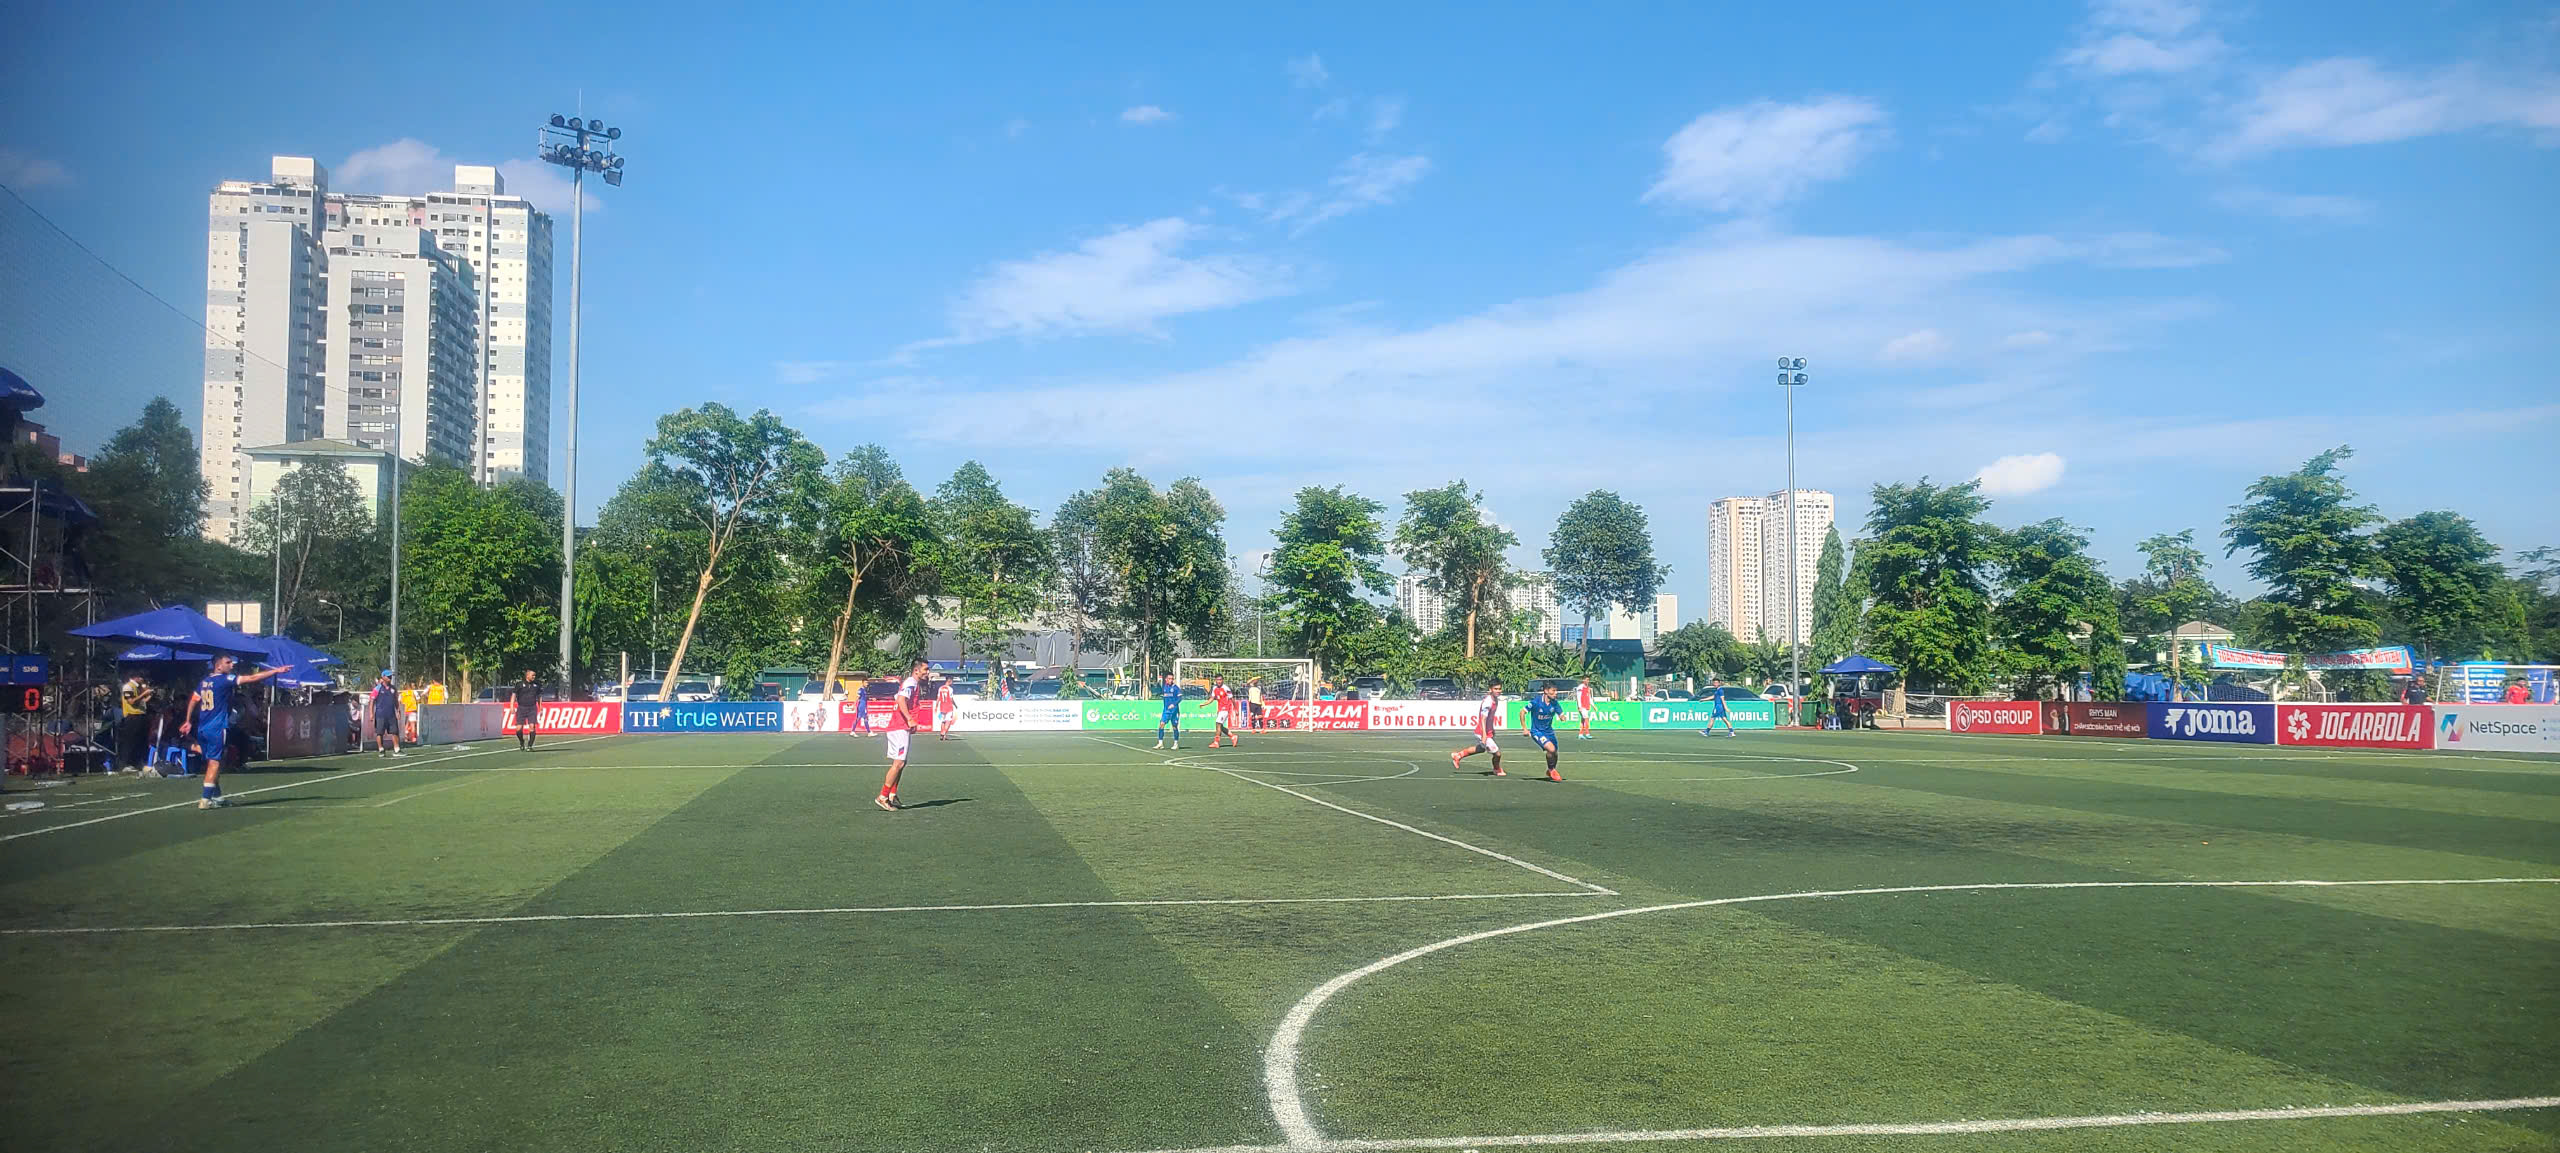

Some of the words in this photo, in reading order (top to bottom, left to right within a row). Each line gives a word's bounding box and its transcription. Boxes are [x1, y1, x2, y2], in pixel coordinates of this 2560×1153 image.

[24, 688, 40, 711] 0
[629, 711, 659, 727] TH
[675, 708, 717, 727] true
[719, 711, 778, 727] WATER
[962, 711, 1015, 721] NetSpace
[1729, 711, 1769, 721] MOBILE
[1971, 709, 1992, 724] PSD
[1994, 709, 2033, 725] GROUP
[1296, 721, 1332, 729] SPORT
[1336, 721, 1360, 729] CARE
[2315, 712, 2421, 741] JOGARBOLA
[2469, 721, 2537, 736] NetSpace
